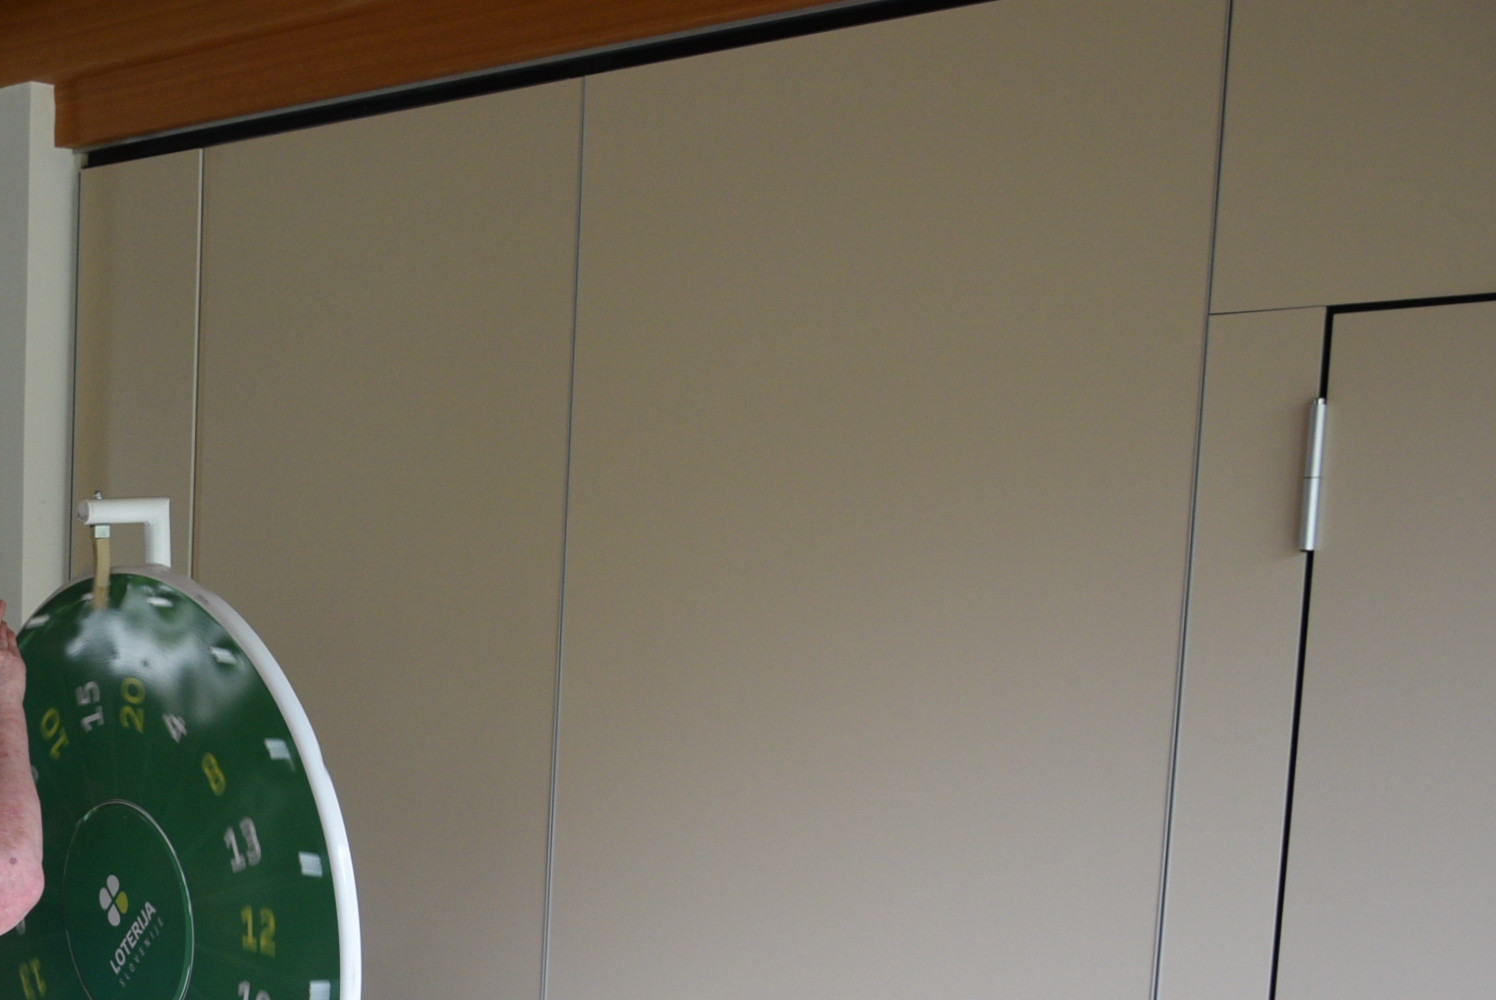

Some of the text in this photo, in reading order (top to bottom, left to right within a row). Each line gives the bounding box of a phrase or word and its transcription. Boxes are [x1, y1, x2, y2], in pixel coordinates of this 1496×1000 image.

[75, 681, 104, 733] 15
[120, 677, 146, 734] 20
[162, 713, 187, 744] 4
[40, 707, 69, 760] 10
[201, 752, 226, 796] 8
[109, 901, 156, 974] LOTERIJA
[241, 905, 276, 957] 12
